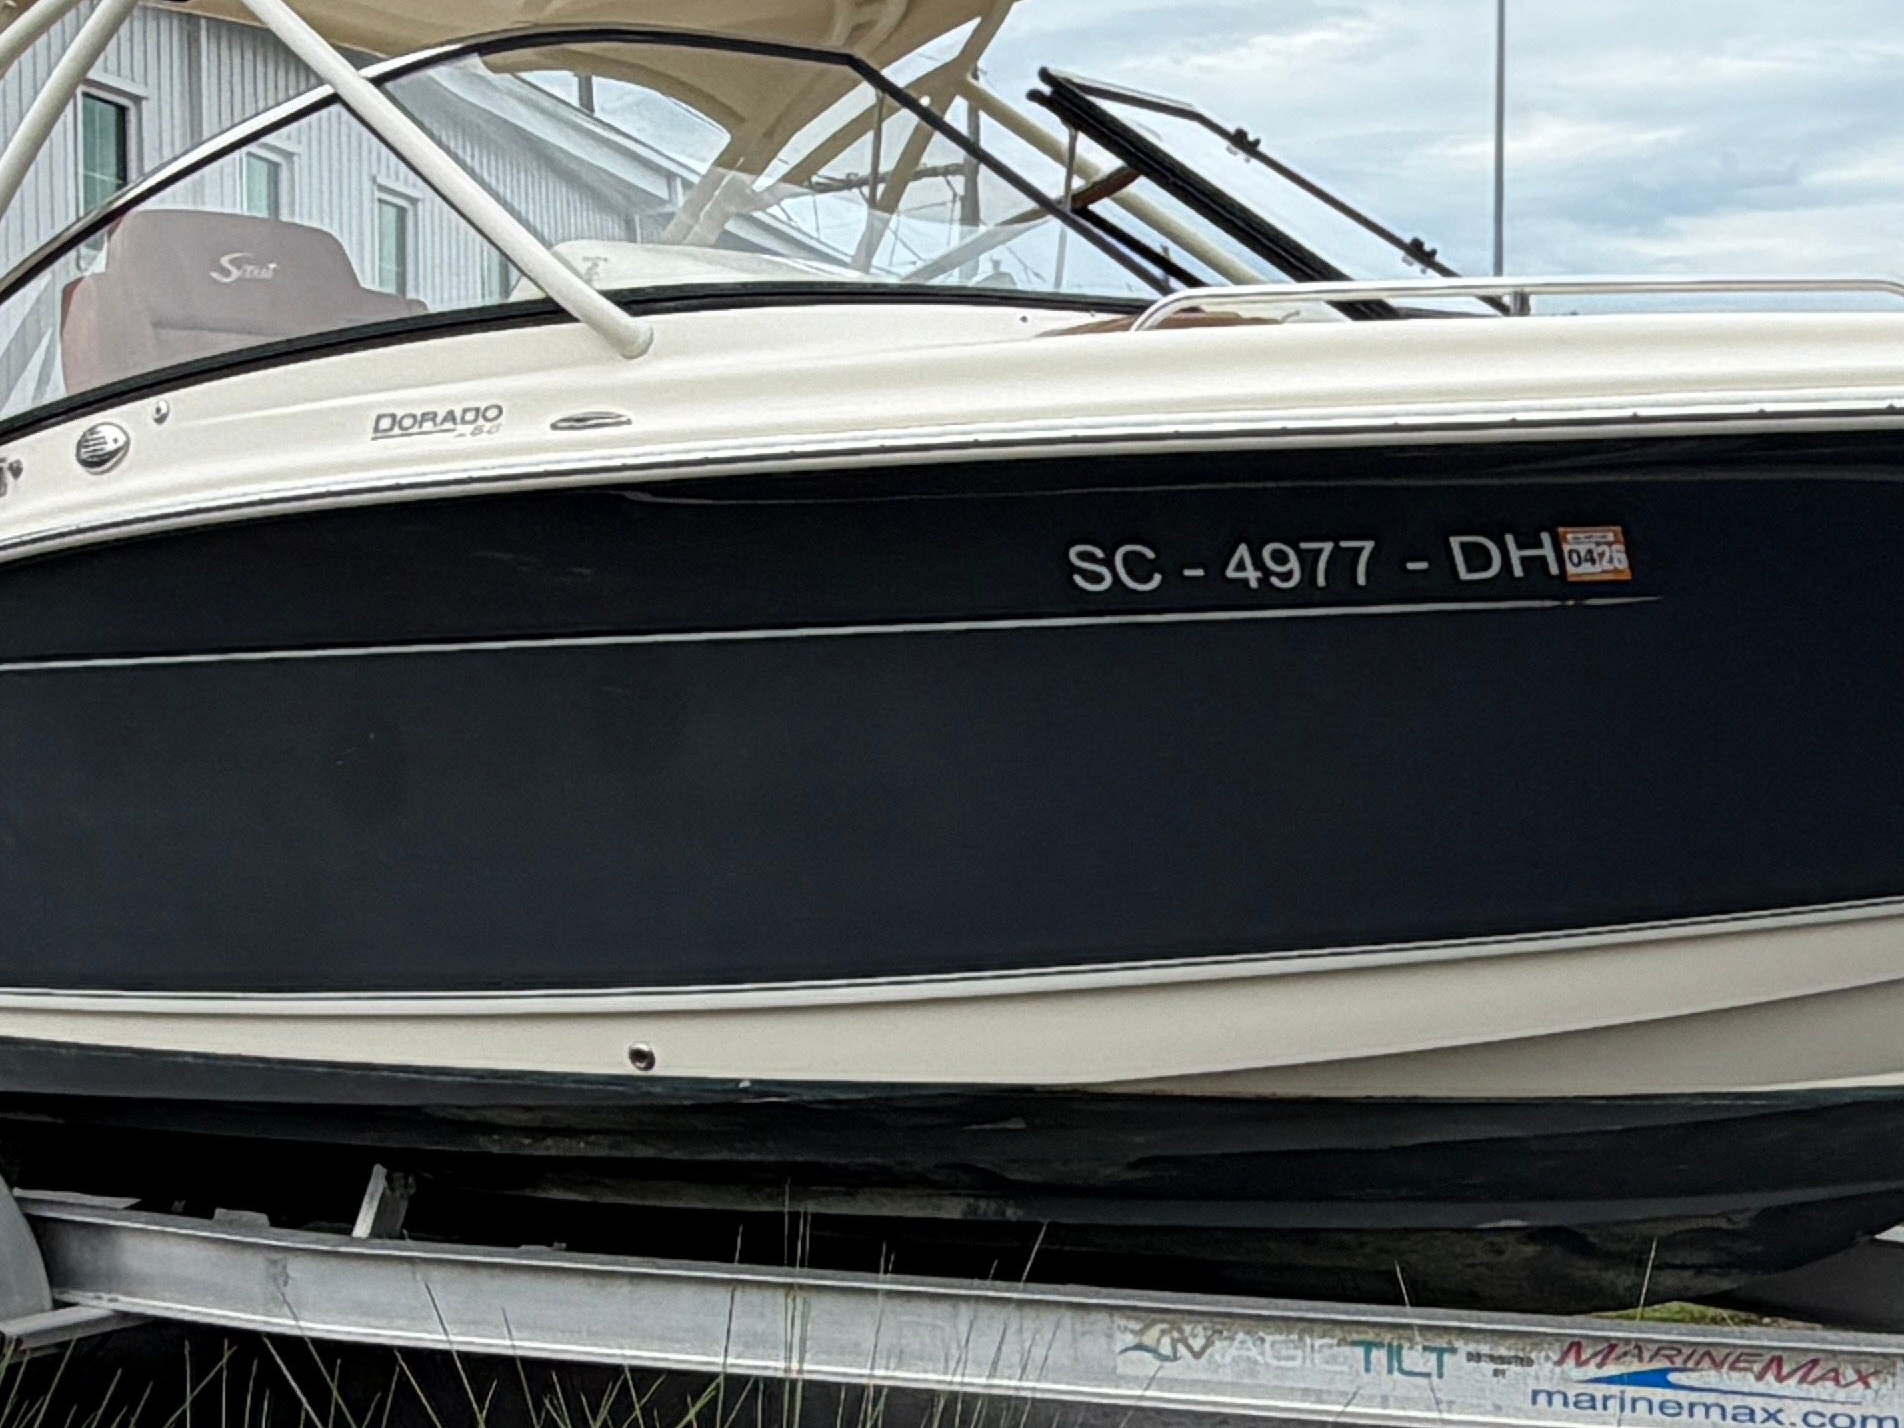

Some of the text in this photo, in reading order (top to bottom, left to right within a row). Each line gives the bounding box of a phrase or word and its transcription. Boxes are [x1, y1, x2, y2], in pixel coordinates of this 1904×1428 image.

[372, 404, 504, 434] DORADO
[1068, 544, 1163, 592] SC
[1224, 540, 1376, 590] 4977
[1448, 531, 1560, 581] DH
[1351, 1339, 1458, 1380] TILT
[1553, 1340, 1880, 1390] MARINEMAX
